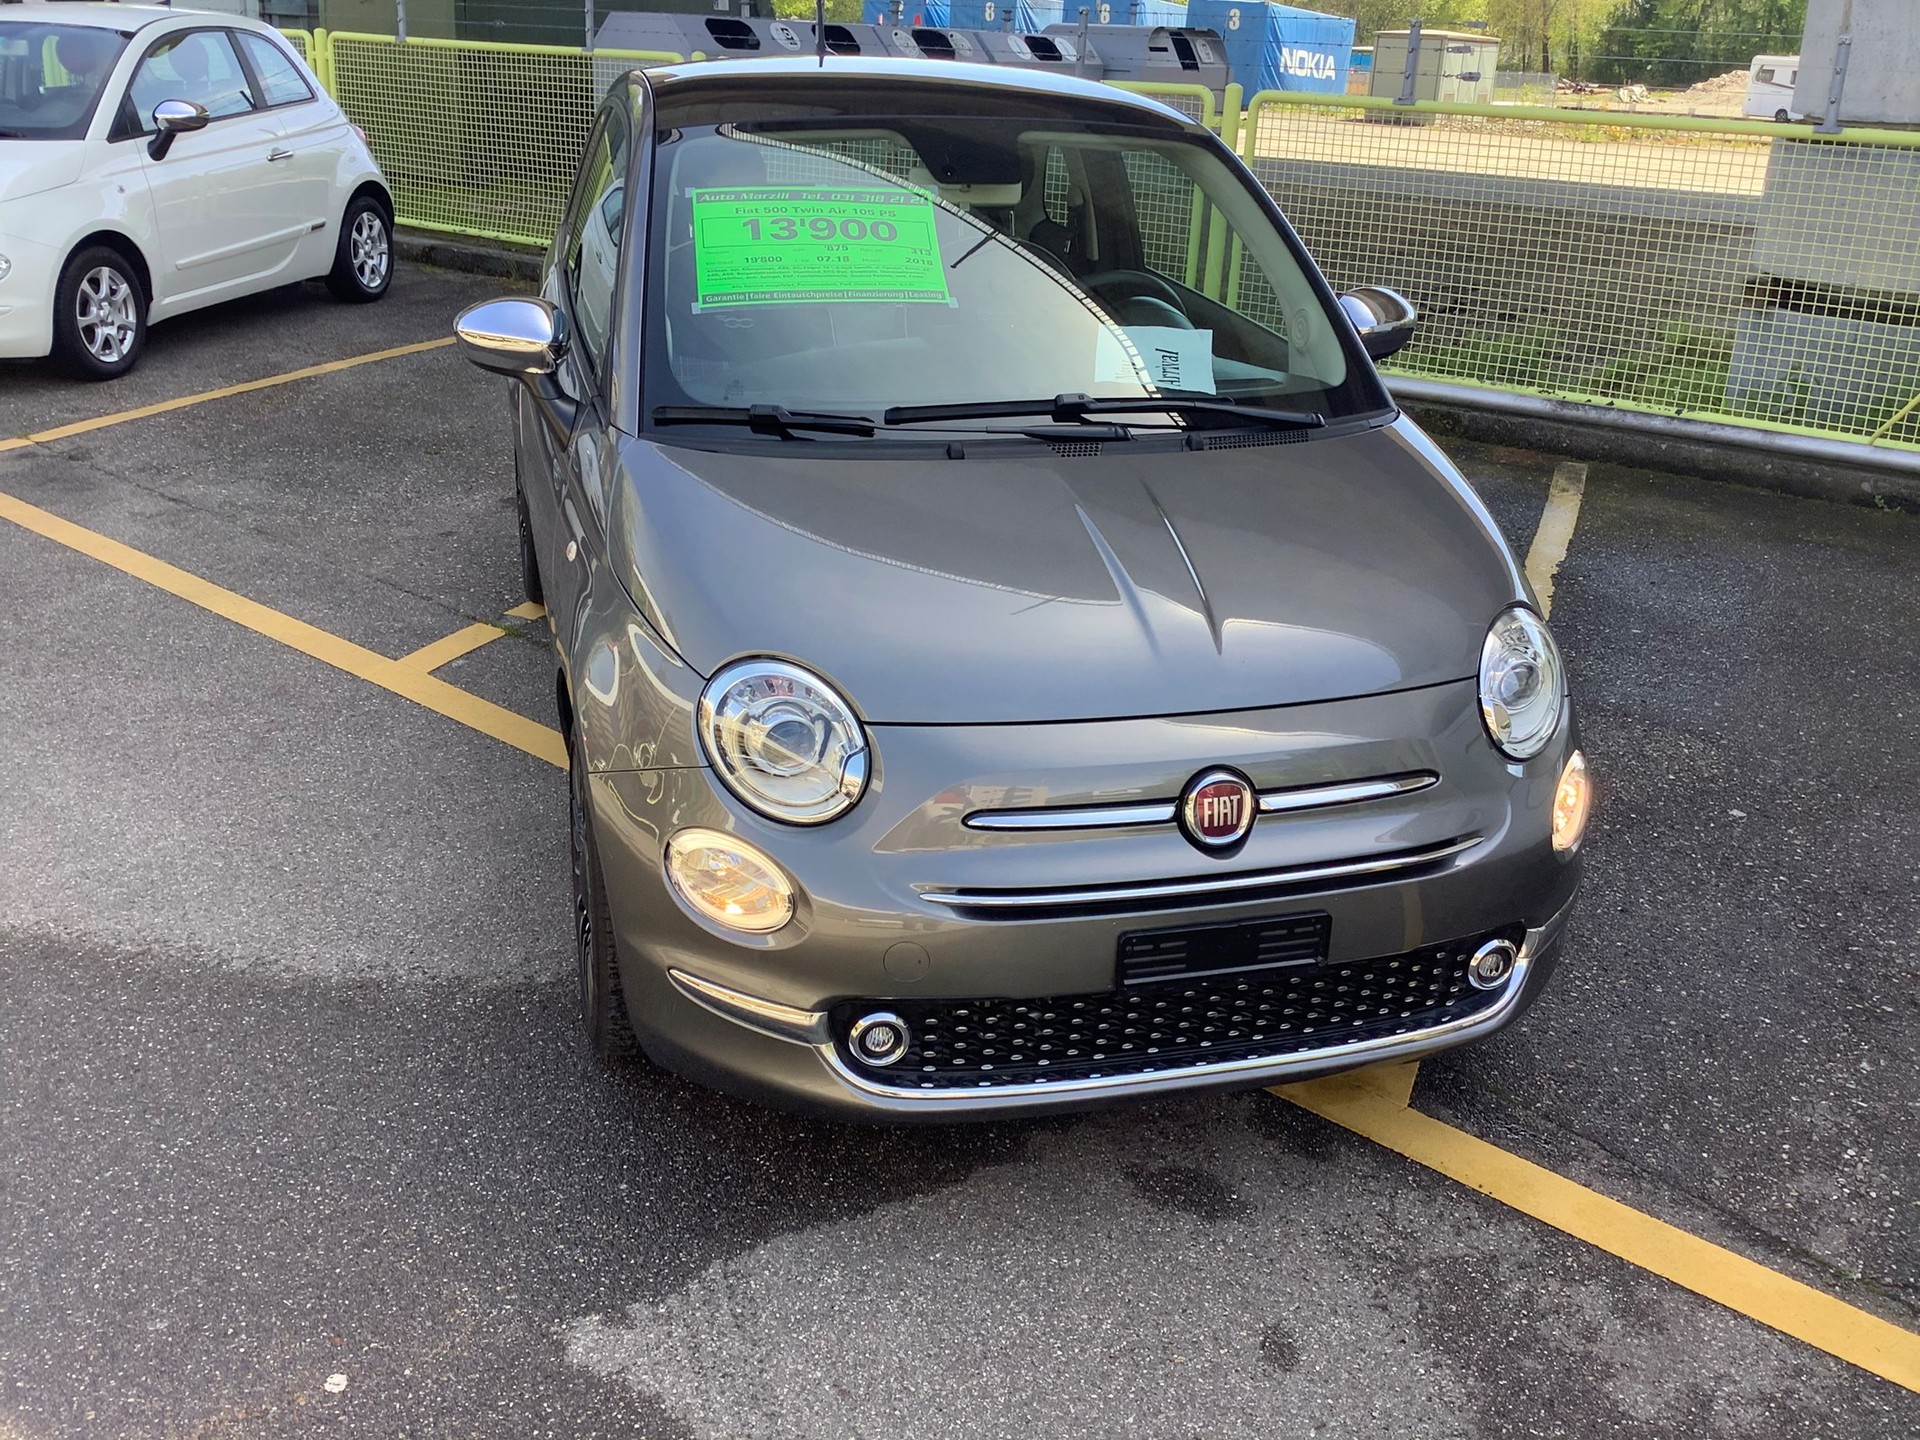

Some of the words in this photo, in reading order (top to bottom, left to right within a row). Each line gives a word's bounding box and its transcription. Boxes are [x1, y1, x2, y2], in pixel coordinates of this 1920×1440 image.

[985, 1, 995, 22] 8
[1100, 3, 1111, 24] 6
[1229, 8, 1241, 31] 3
[1280, 47, 1336, 80] NOKIA
[700, 194, 735, 202] Auto
[801, 192, 824, 200] Tel.
[831, 193, 855, 201] 031
[861, 194, 885, 202] 318
[889, 195, 905, 204] 21
[910, 196, 925, 204] 21
[763, 206, 788, 214] 500
[852, 208, 875, 216] 105
[879, 209, 896, 217] PS
[742, 217, 898, 242] 13'900
[816, 255, 850, 263] 07.18
[905, 257, 934, 266] 2018
[705, 293, 745, 302] Garantie
[773, 291, 843, 299] Eintauschpreise
[848, 291, 904, 299] Finanzierung
[909, 291, 943, 300] Leasing
[1155, 348, 1181, 387] Arrival
[1203, 794, 1241, 828] FIAT
